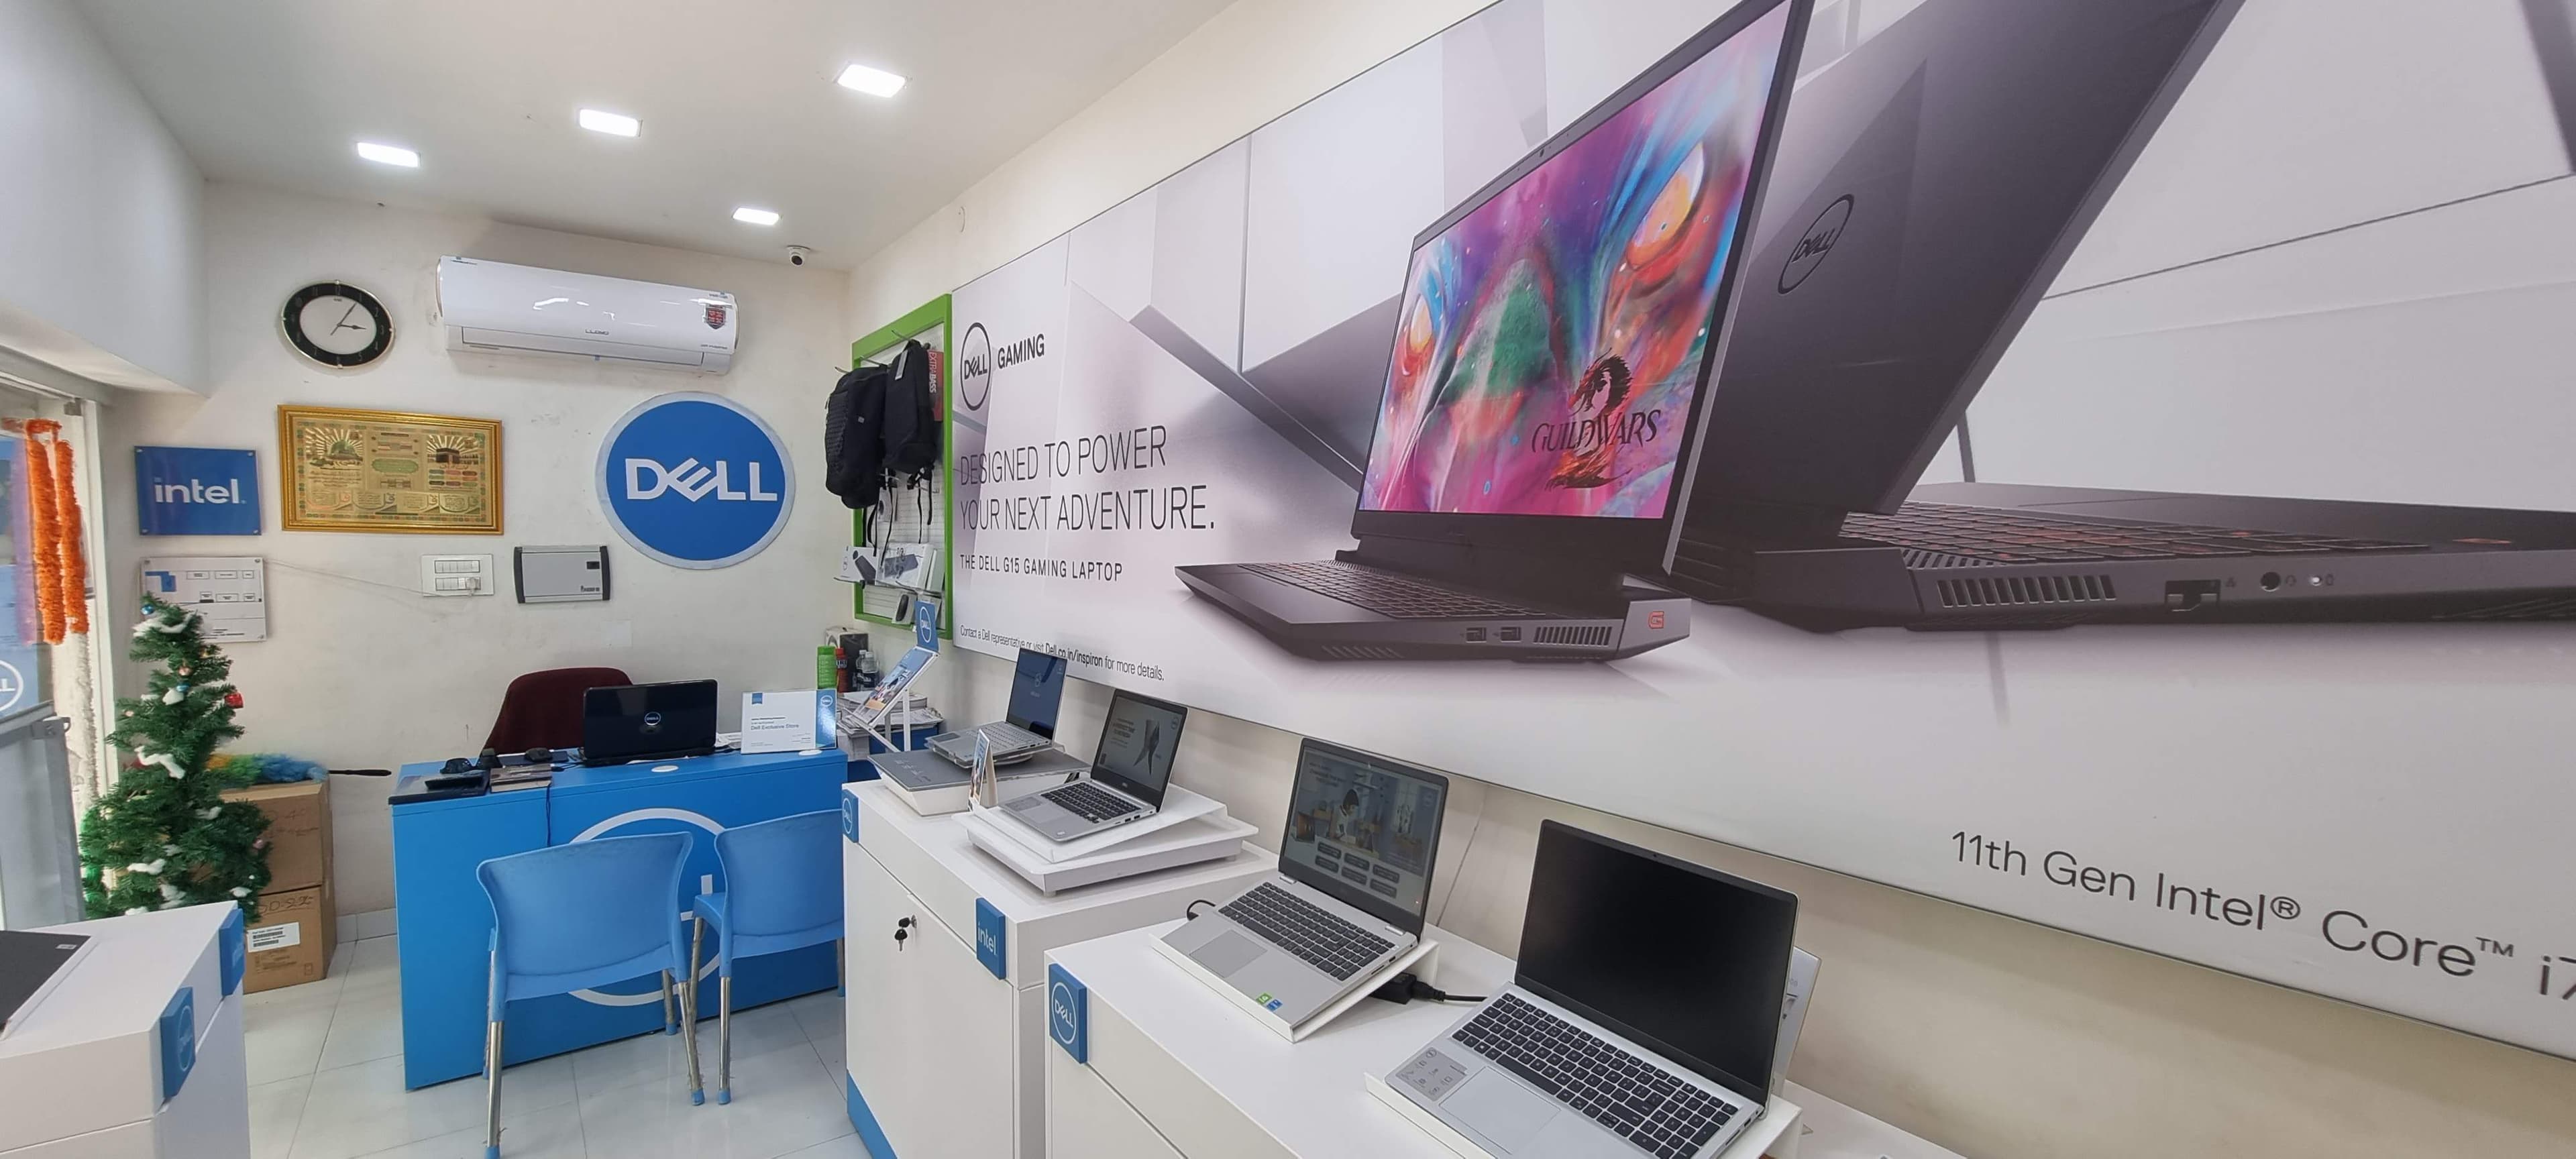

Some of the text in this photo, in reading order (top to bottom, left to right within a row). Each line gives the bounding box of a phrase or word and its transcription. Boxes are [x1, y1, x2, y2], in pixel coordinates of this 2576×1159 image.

[1791, 228, 1835, 262] DELL
[964, 333, 1044, 380] DELL GAMING
[960, 425, 1167, 486] DESIGNED TO POWER
[625, 457, 778, 502] DELL
[960, 485, 1215, 530] YOUR NEXT ADVENTURE.
[960, 554, 1122, 582] THE DELL G15 GAMING LAPTOP
[960, 624, 977, 638] Contact
[978, 630, 981, 639] a
[981, 629, 990, 641] Dell
[1045, 643, 1104, 667] Dell.coin/inspiron
[1105, 656, 1116, 670] for
[1116, 661, 1136, 675] more
[1137, 662, 1165, 681] details.
[1952, 831, 2027, 876] 11th
[2043, 851, 2135, 901] Gen
[1055, 999, 1075, 1029] DELL
